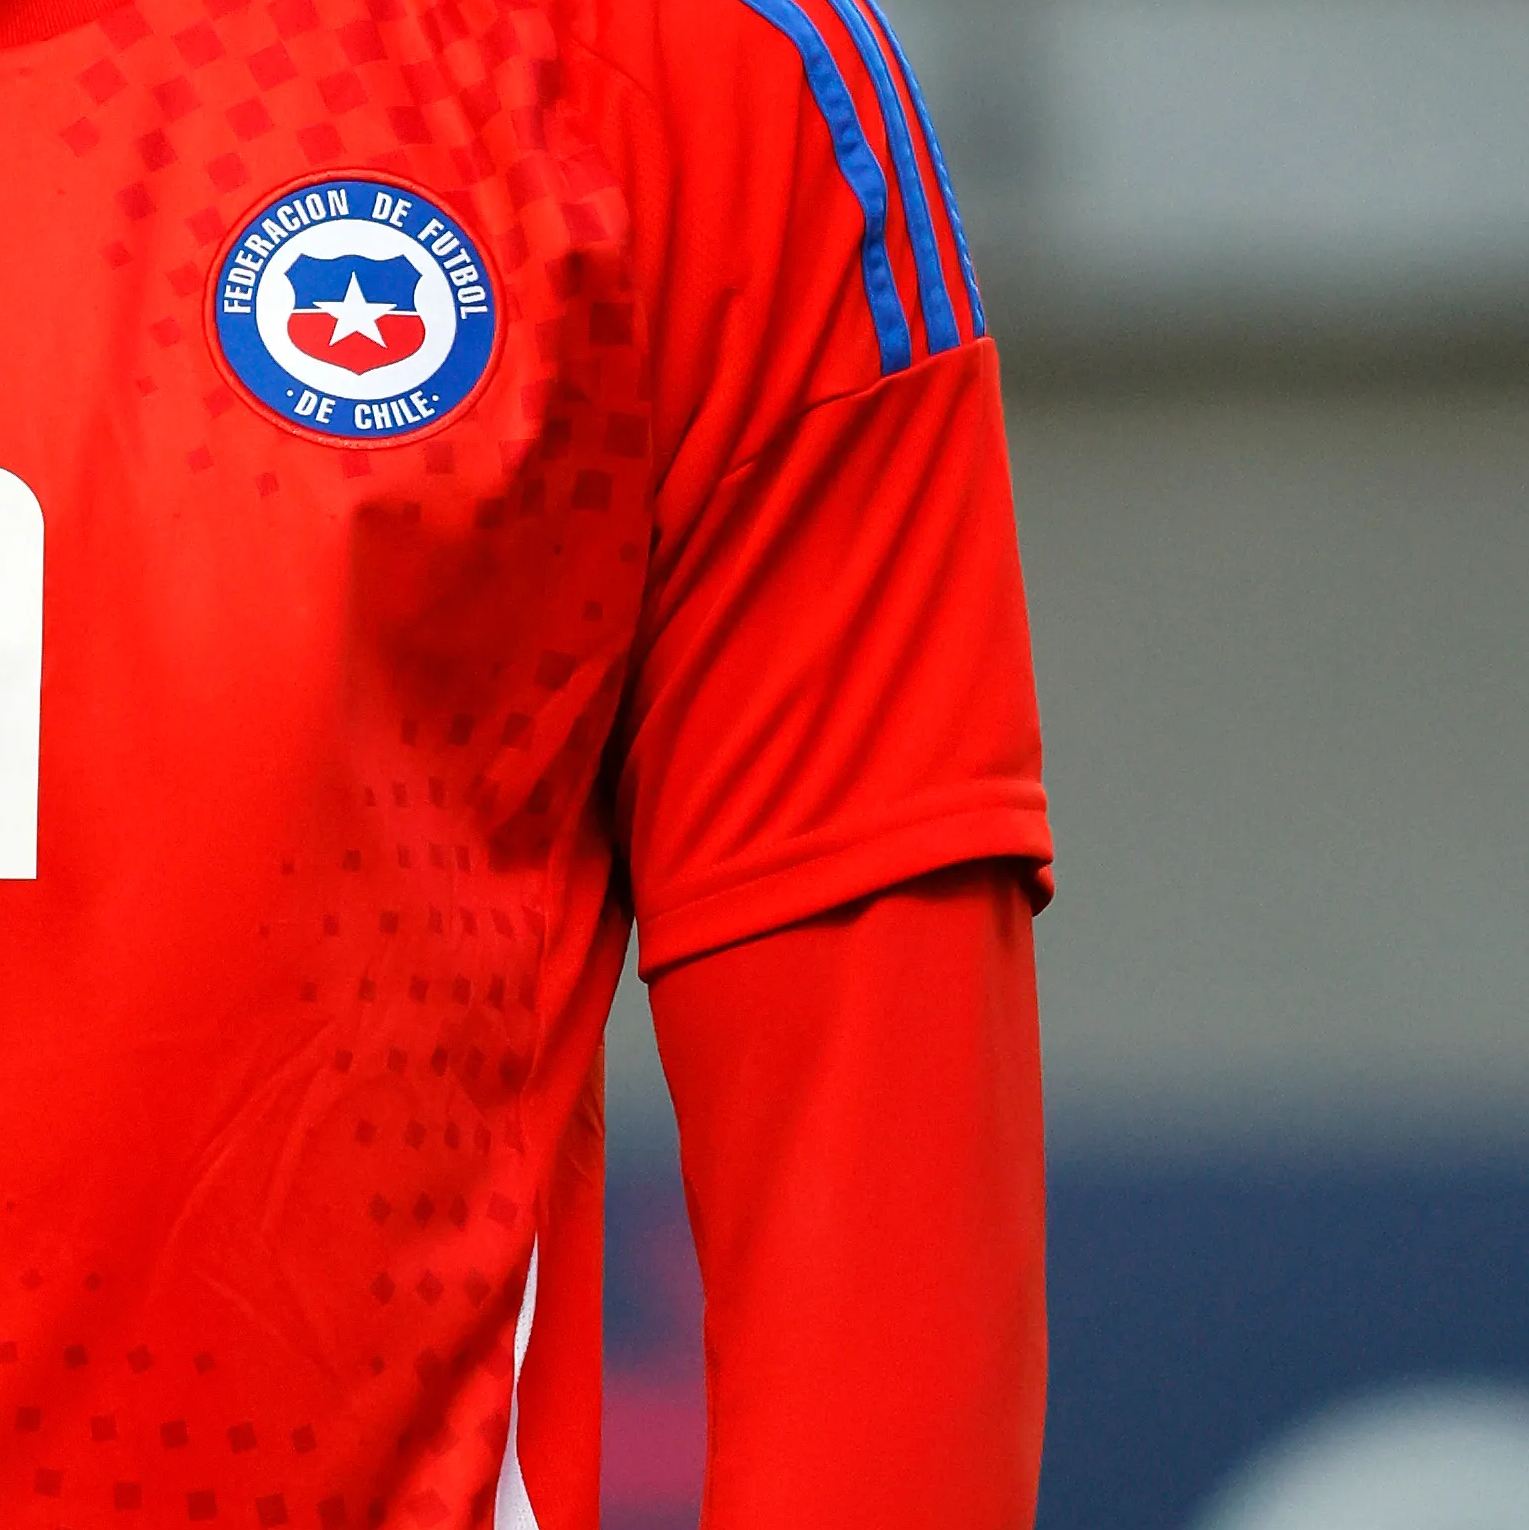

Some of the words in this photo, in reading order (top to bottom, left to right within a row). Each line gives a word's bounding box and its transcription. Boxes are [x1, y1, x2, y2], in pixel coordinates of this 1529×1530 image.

[223, 189, 350, 314] FEDERACION
[372, 191, 412, 227] DE
[418, 218, 488, 320] FUTBOL
[294, 397, 336, 424] DE
[354, 390, 435, 430] CHILE
